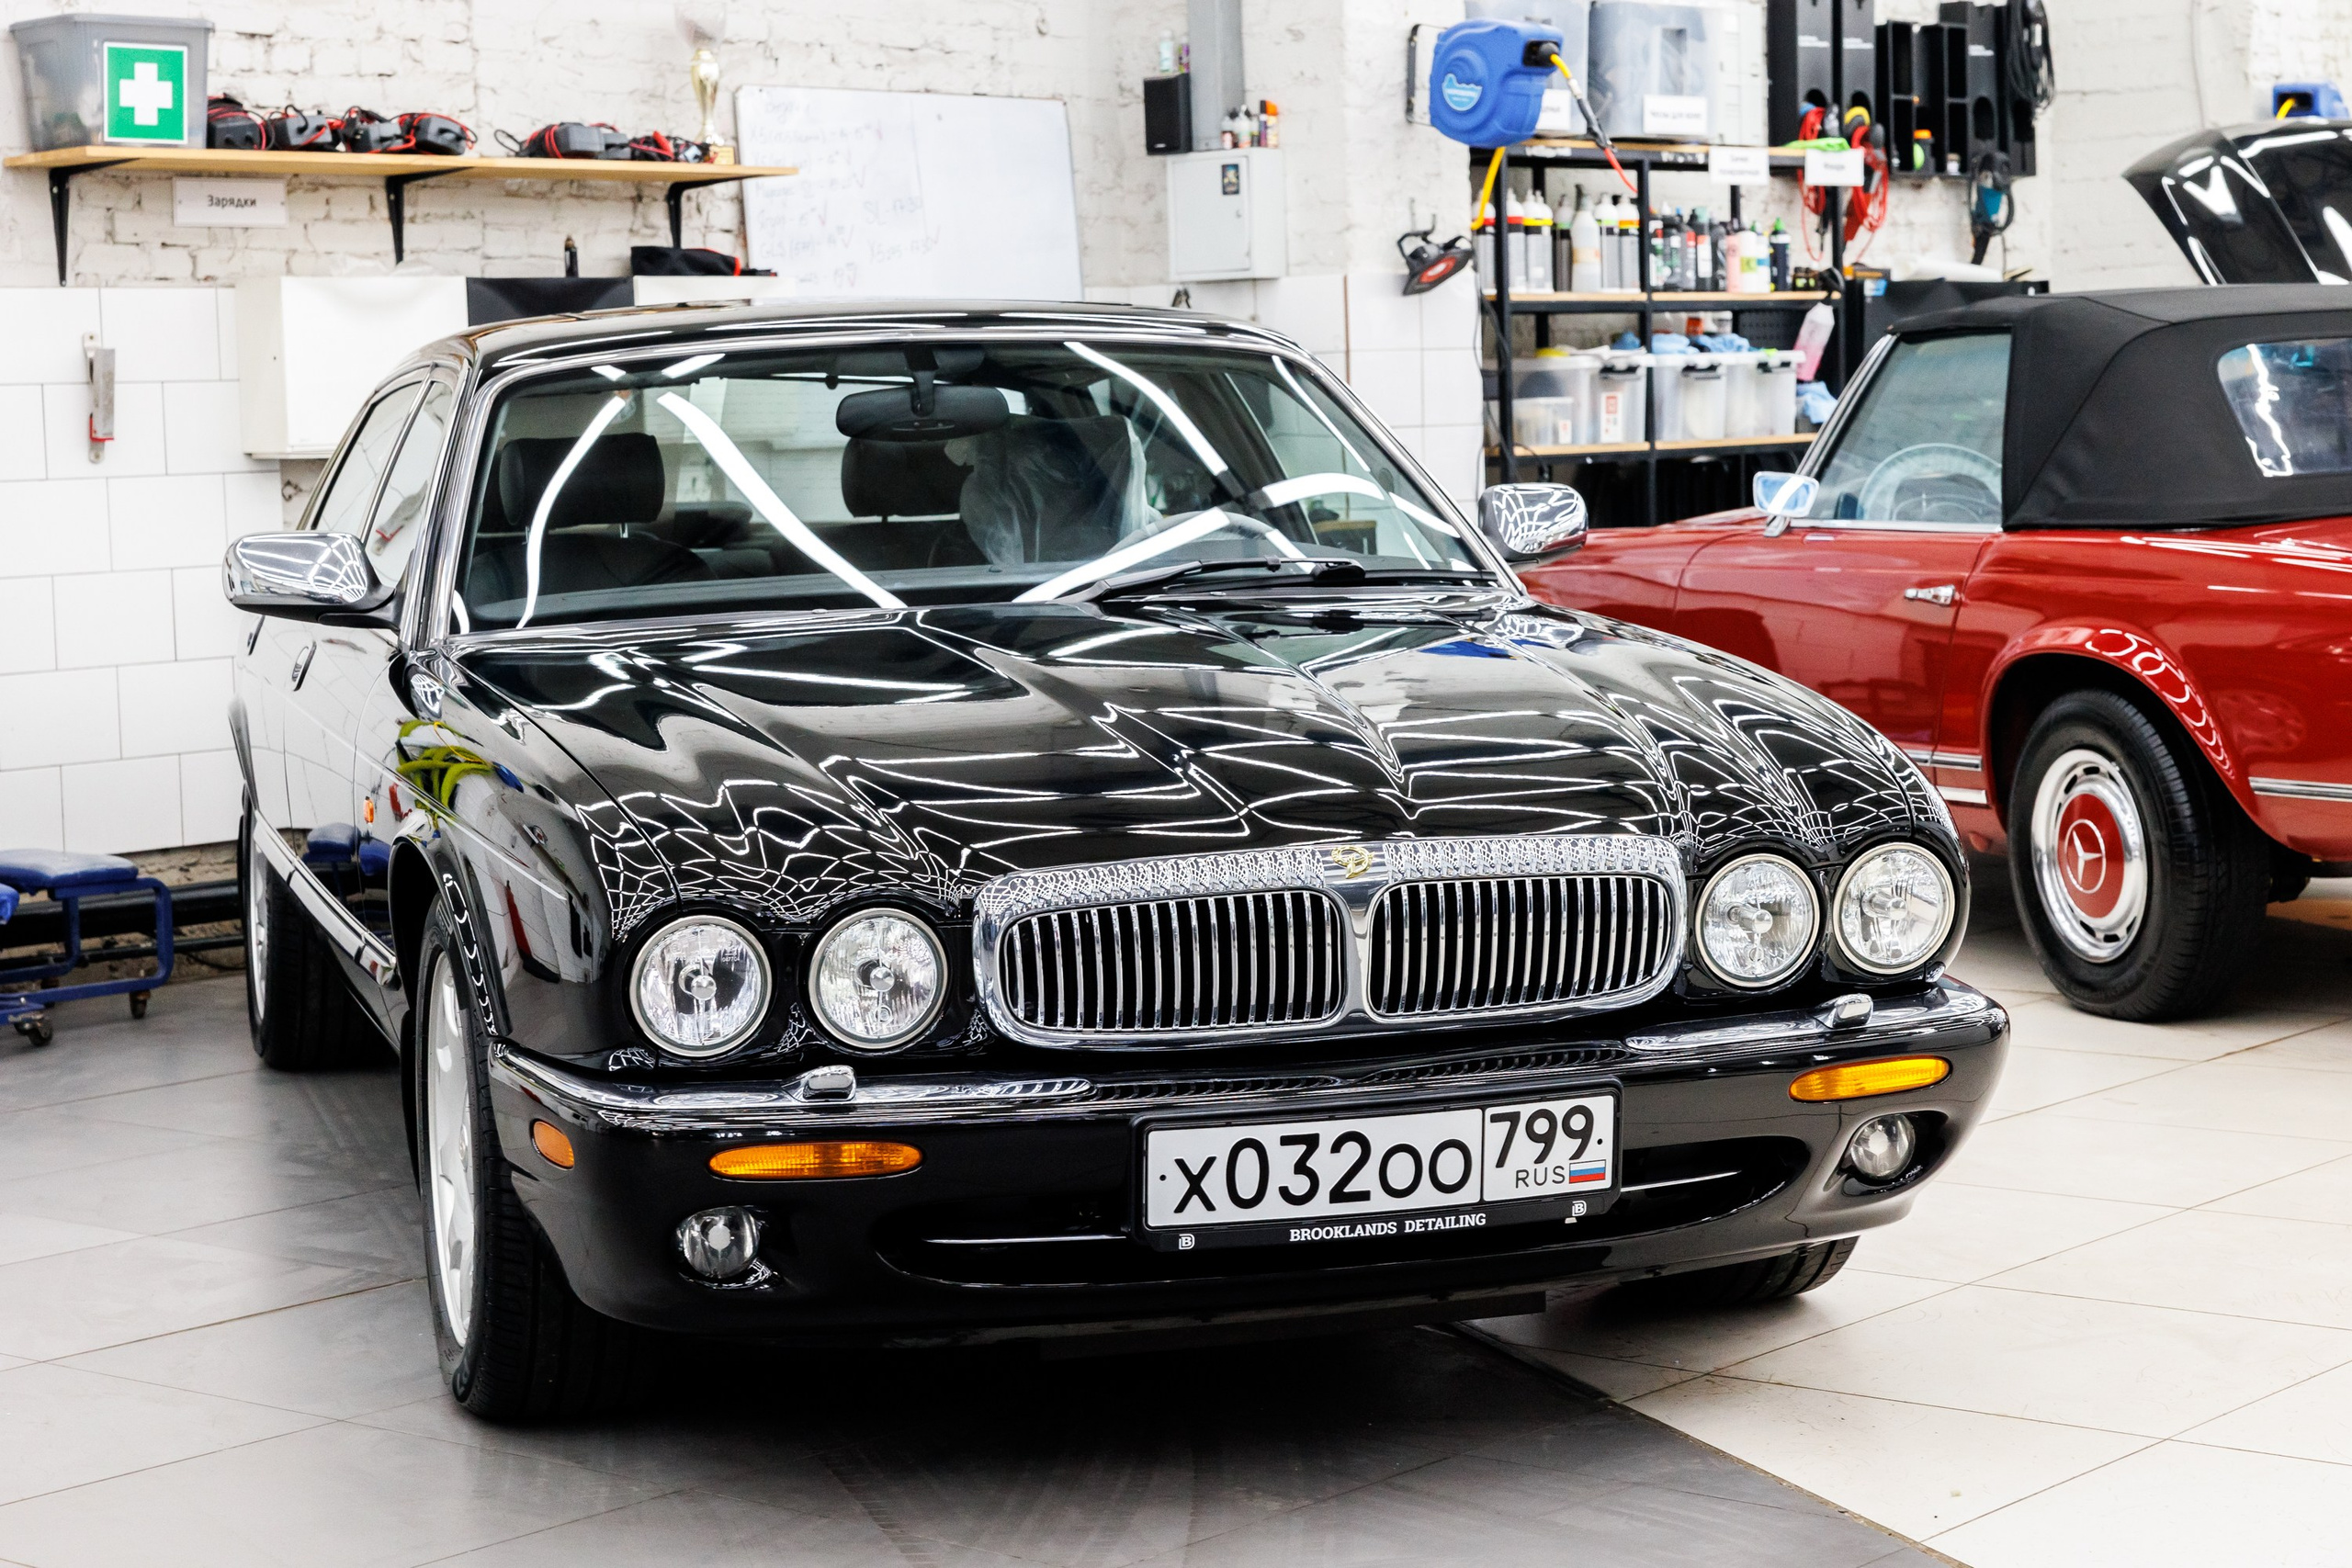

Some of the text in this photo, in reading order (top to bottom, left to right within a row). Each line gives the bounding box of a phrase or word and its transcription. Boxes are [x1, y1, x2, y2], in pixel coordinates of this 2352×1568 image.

[207, 194, 256, 209] Зарядки
[1489, 1104, 1595, 1168] 799
[1515, 1165, 1566, 1190] RUS
[1289, 1213, 1487, 1242] BROOKLANDS DETAILING
